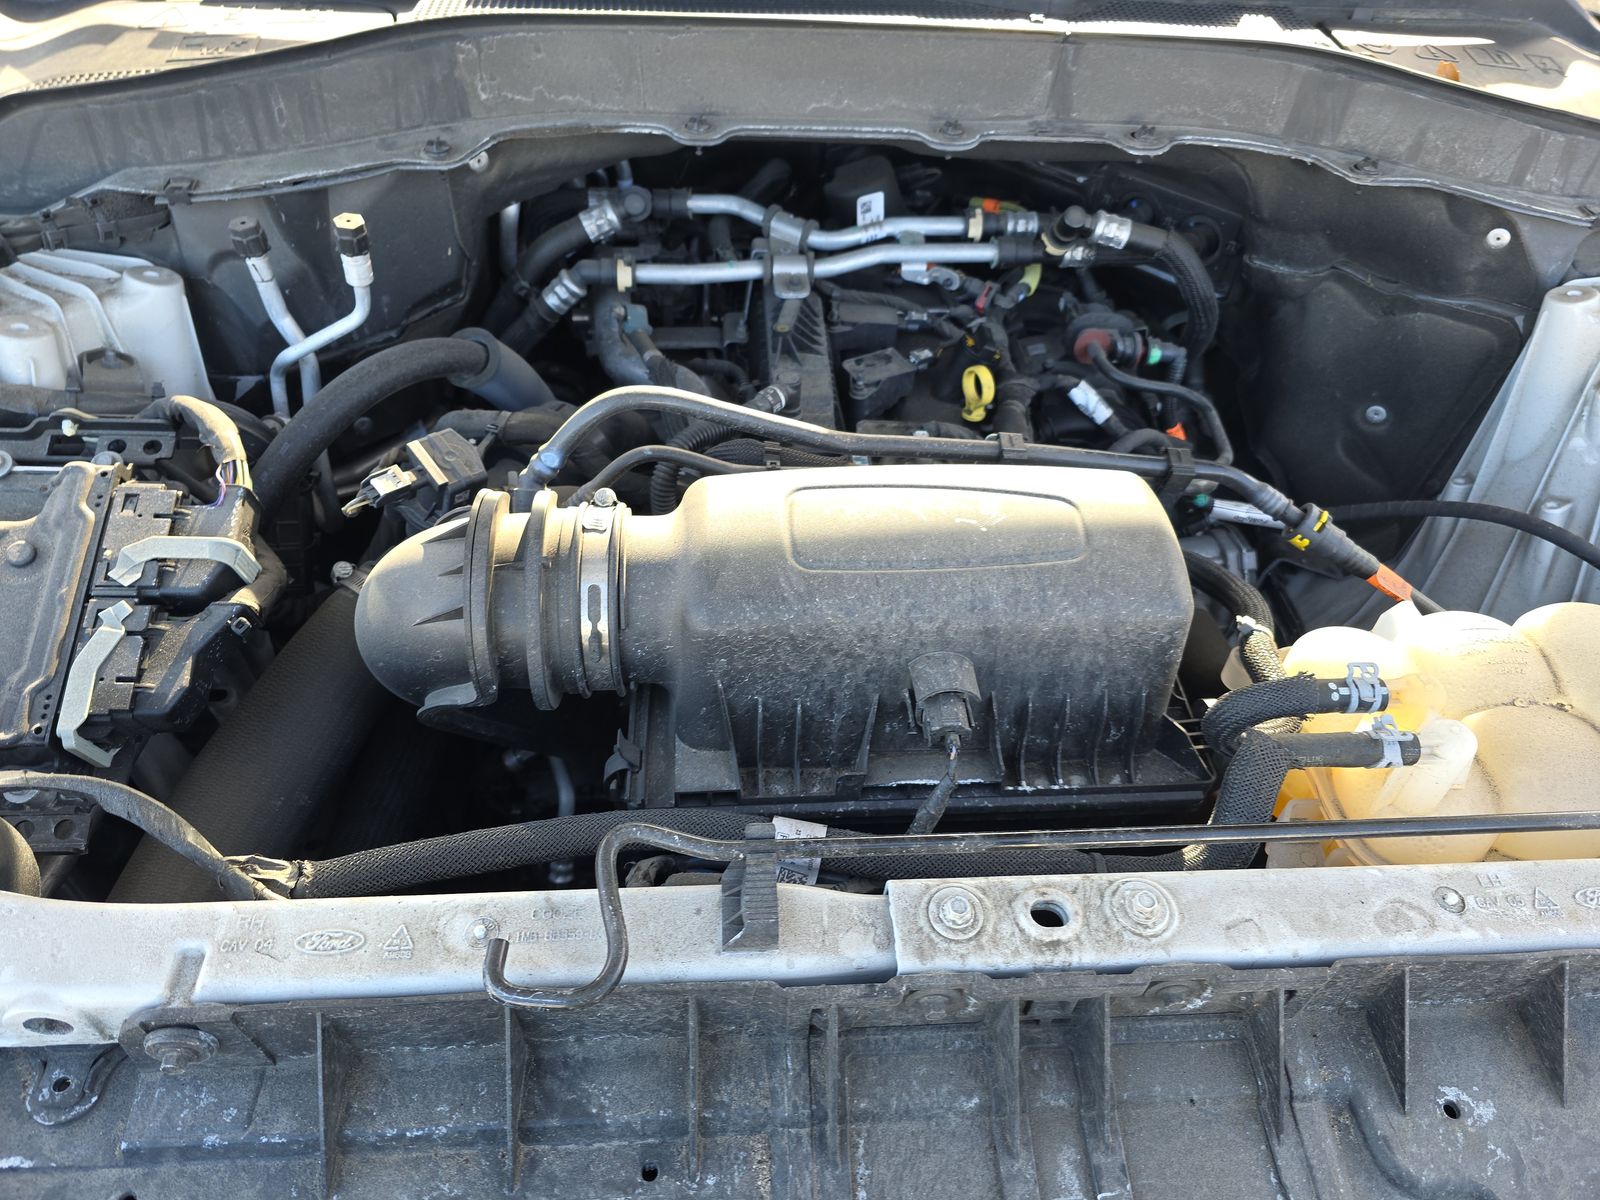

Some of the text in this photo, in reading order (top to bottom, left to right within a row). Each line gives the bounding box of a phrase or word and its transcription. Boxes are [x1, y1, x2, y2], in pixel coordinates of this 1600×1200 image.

[1476, 873, 1504, 888] LH
[220, 938, 275, 952] CAV 04
[306, 933, 356, 951] Ford
